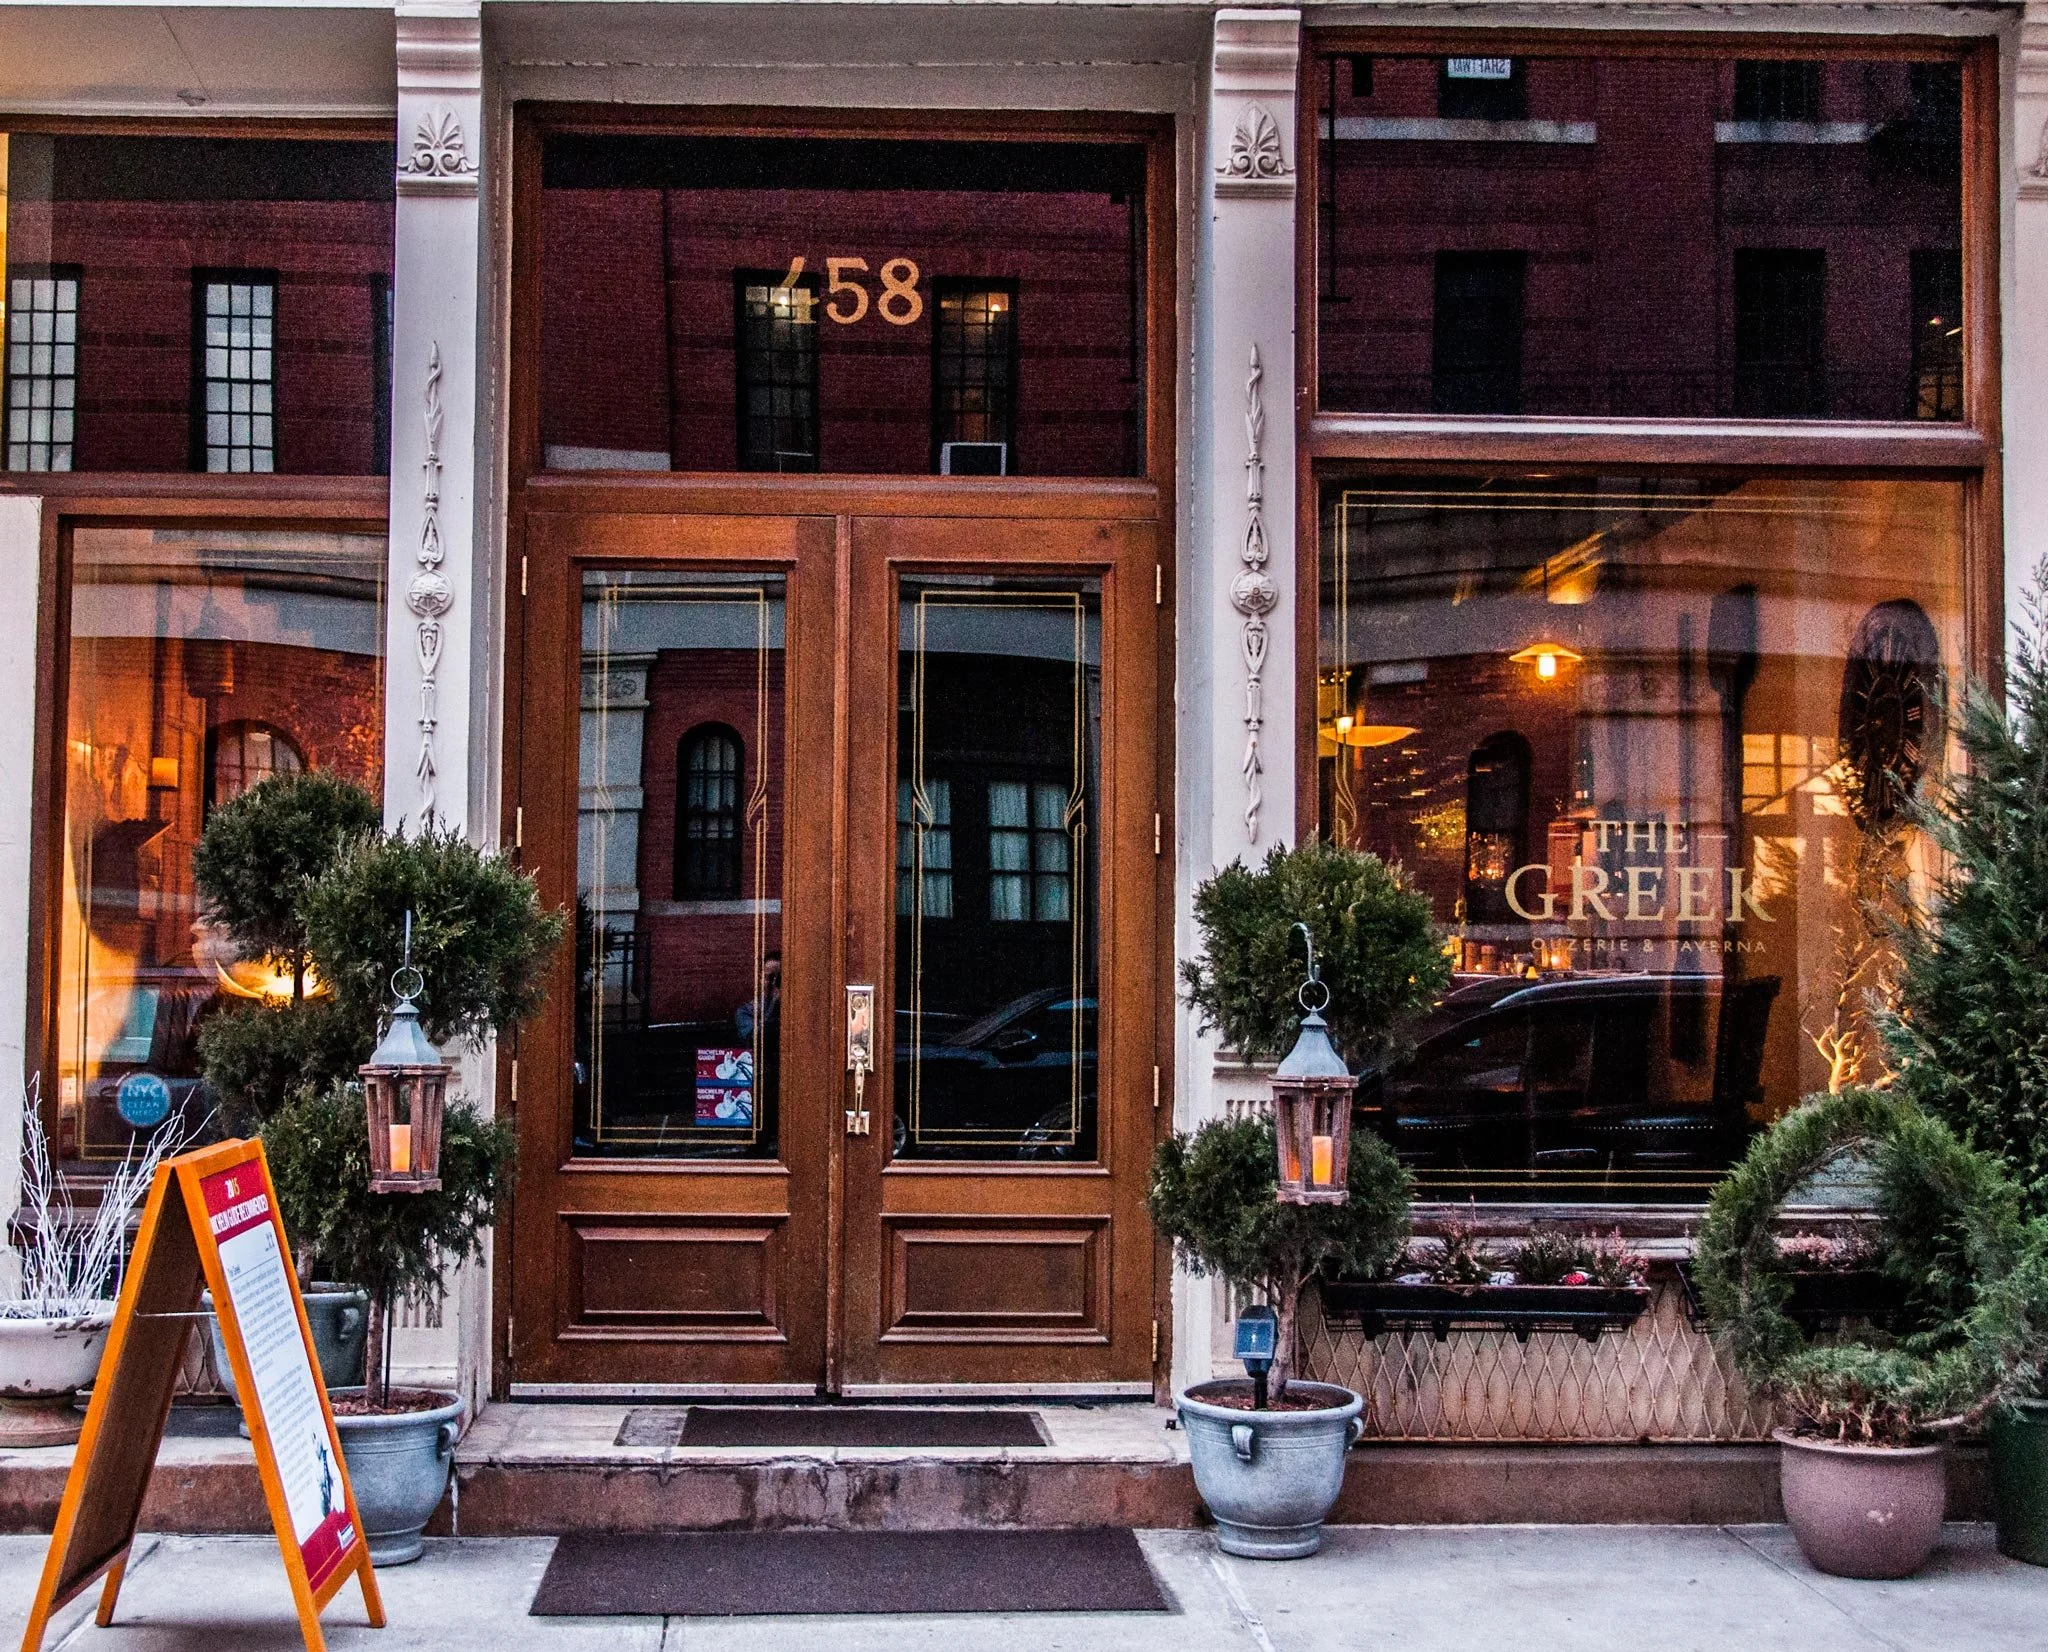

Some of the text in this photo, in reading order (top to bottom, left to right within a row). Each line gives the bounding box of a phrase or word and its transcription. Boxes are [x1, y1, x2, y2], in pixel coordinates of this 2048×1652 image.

[1589, 820, 1688, 853] THE
[1505, 863, 1777, 923] GREEK
[1643, 938, 1655, 952] &
[1667, 938, 1768, 953] TAVERNA
[127, 1084, 161, 1098] NYC
